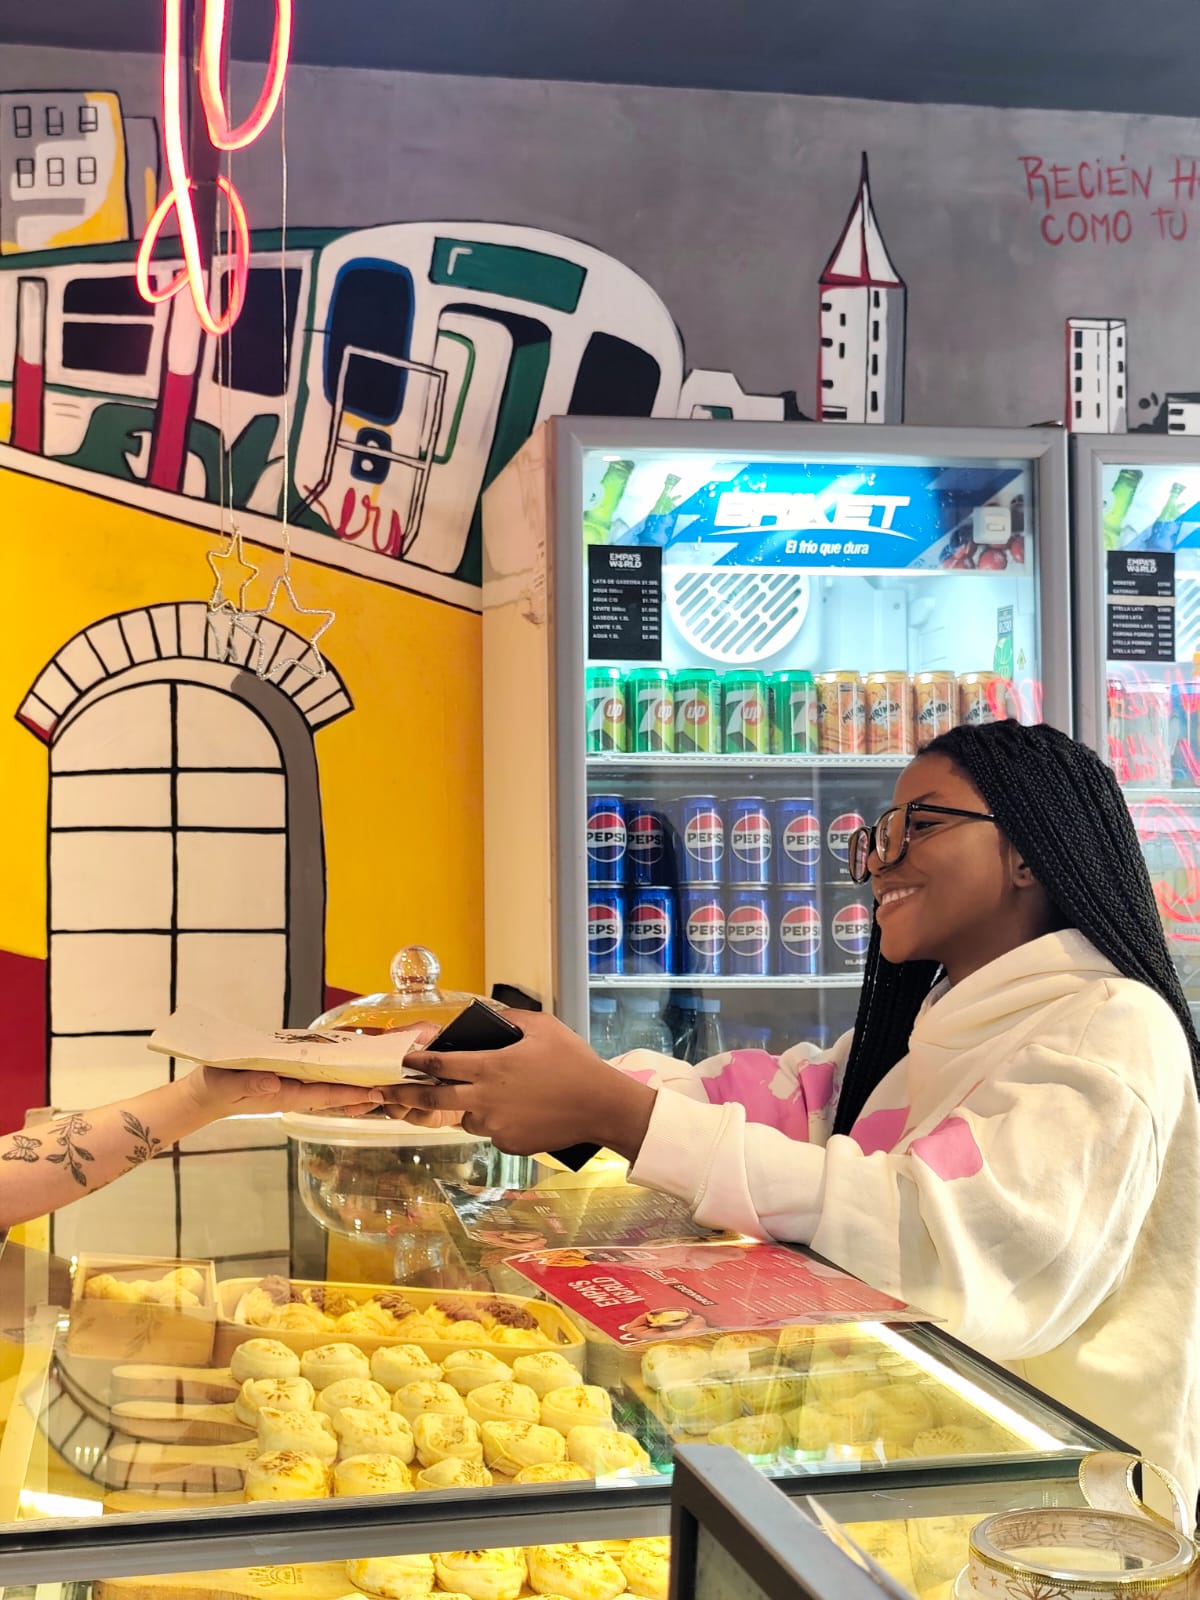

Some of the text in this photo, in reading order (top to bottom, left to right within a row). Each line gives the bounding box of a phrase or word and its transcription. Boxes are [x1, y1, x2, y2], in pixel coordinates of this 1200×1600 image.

[1168, 157, 1200, 200] H
[1041, 207, 1187, 246] COMO TU
[785, 540, 796, 554] El
[820, 543, 841, 558] que
[843, 541, 870, 555] dura
[628, 834, 663, 845] PEPS
[687, 832, 723, 844] PEPS
[786, 835, 820, 846] PEPS
[689, 925, 725, 936] PEPS
[727, 925, 768, 937] PEPSI
[834, 923, 869, 935] PEPS
